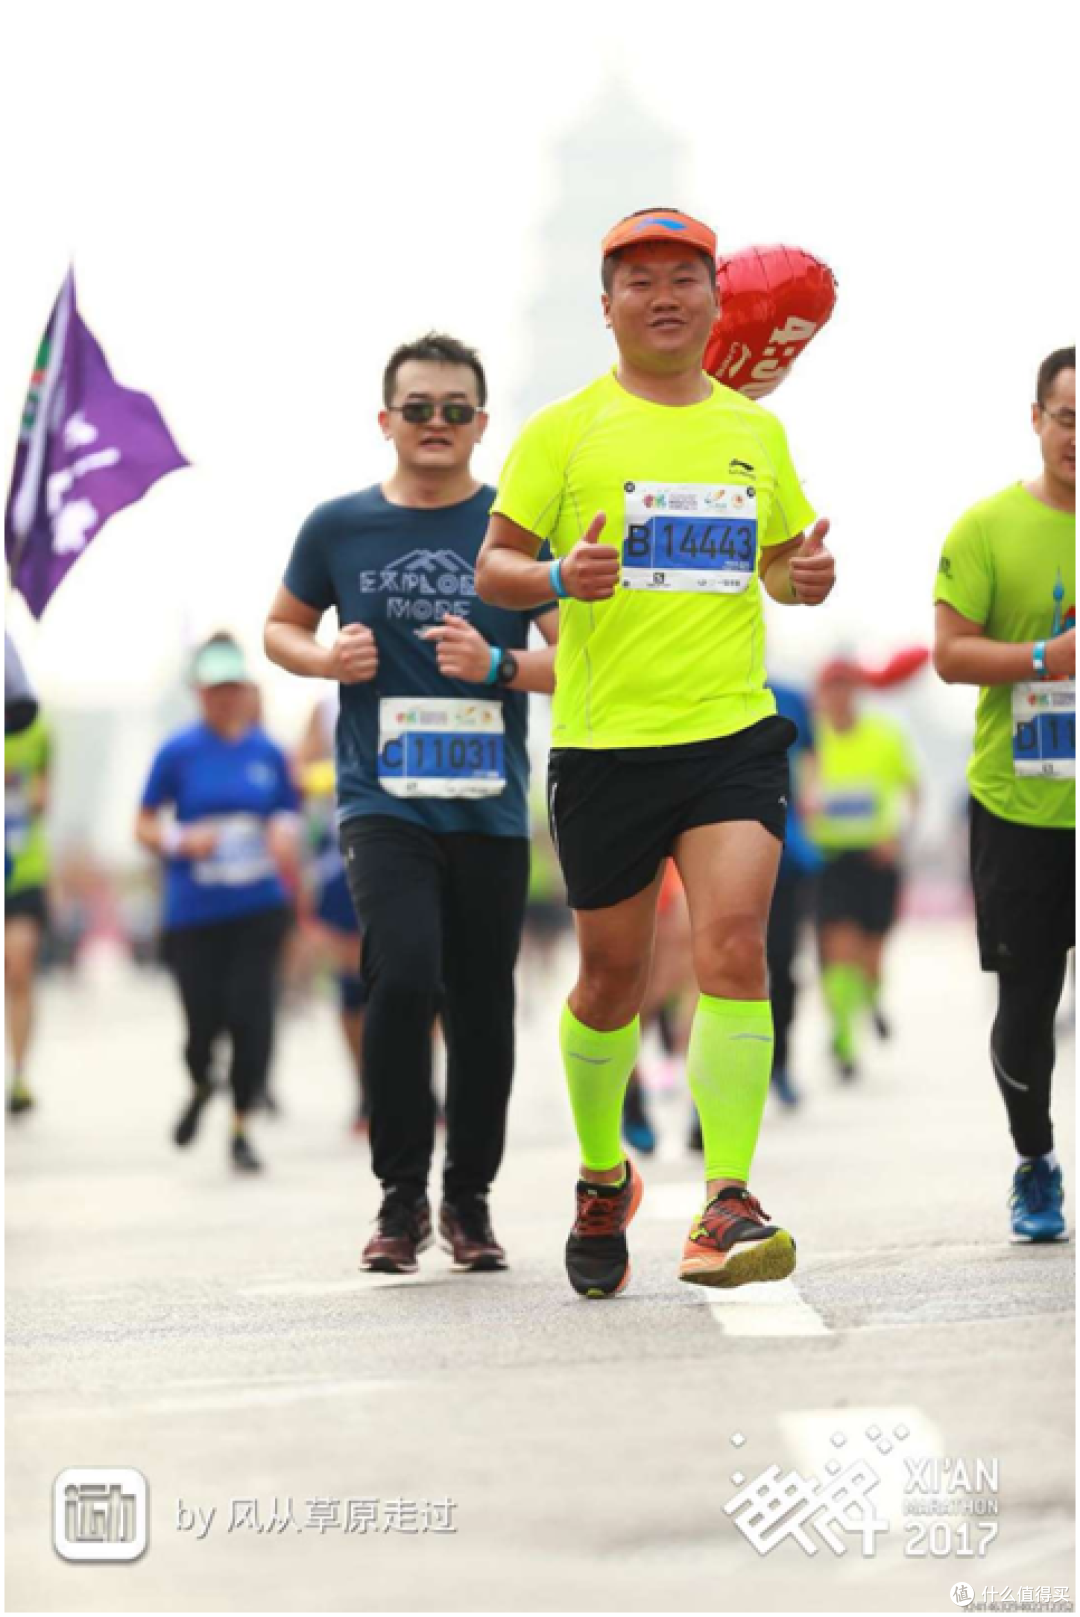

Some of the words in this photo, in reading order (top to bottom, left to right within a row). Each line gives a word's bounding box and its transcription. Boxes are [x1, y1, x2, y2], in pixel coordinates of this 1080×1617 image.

[628, 524, 650, 558] B
[663, 523, 752, 561] 14443
[360, 569, 477, 596] EXPLOR
[1016, 721, 1038, 752] D
[382, 738, 403, 769] C
[414, 736, 498, 770] 11031
